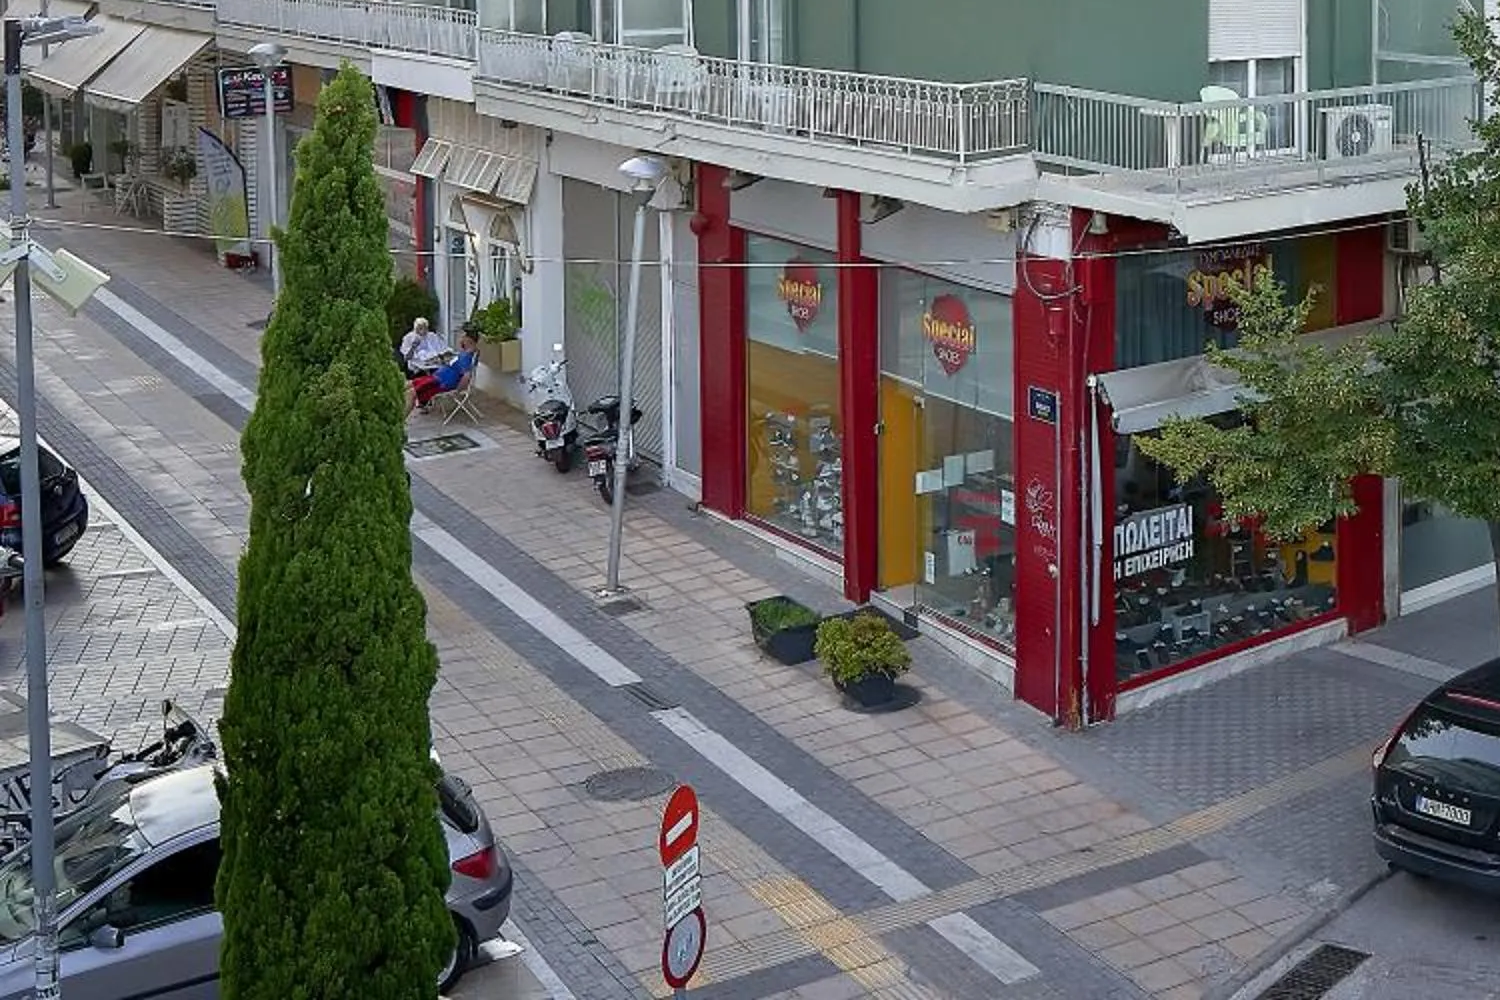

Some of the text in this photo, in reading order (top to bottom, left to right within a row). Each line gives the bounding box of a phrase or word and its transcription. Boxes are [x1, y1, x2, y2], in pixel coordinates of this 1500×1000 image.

[777, 274, 822, 304] Special
[923, 312, 976, 352] Special
[1113, 505, 1194, 558] ΠΩΛΕΙΤΑΙ
[1124, 539, 1194, 577] ΕΠΙΧΕΙΡΗΣΗ
